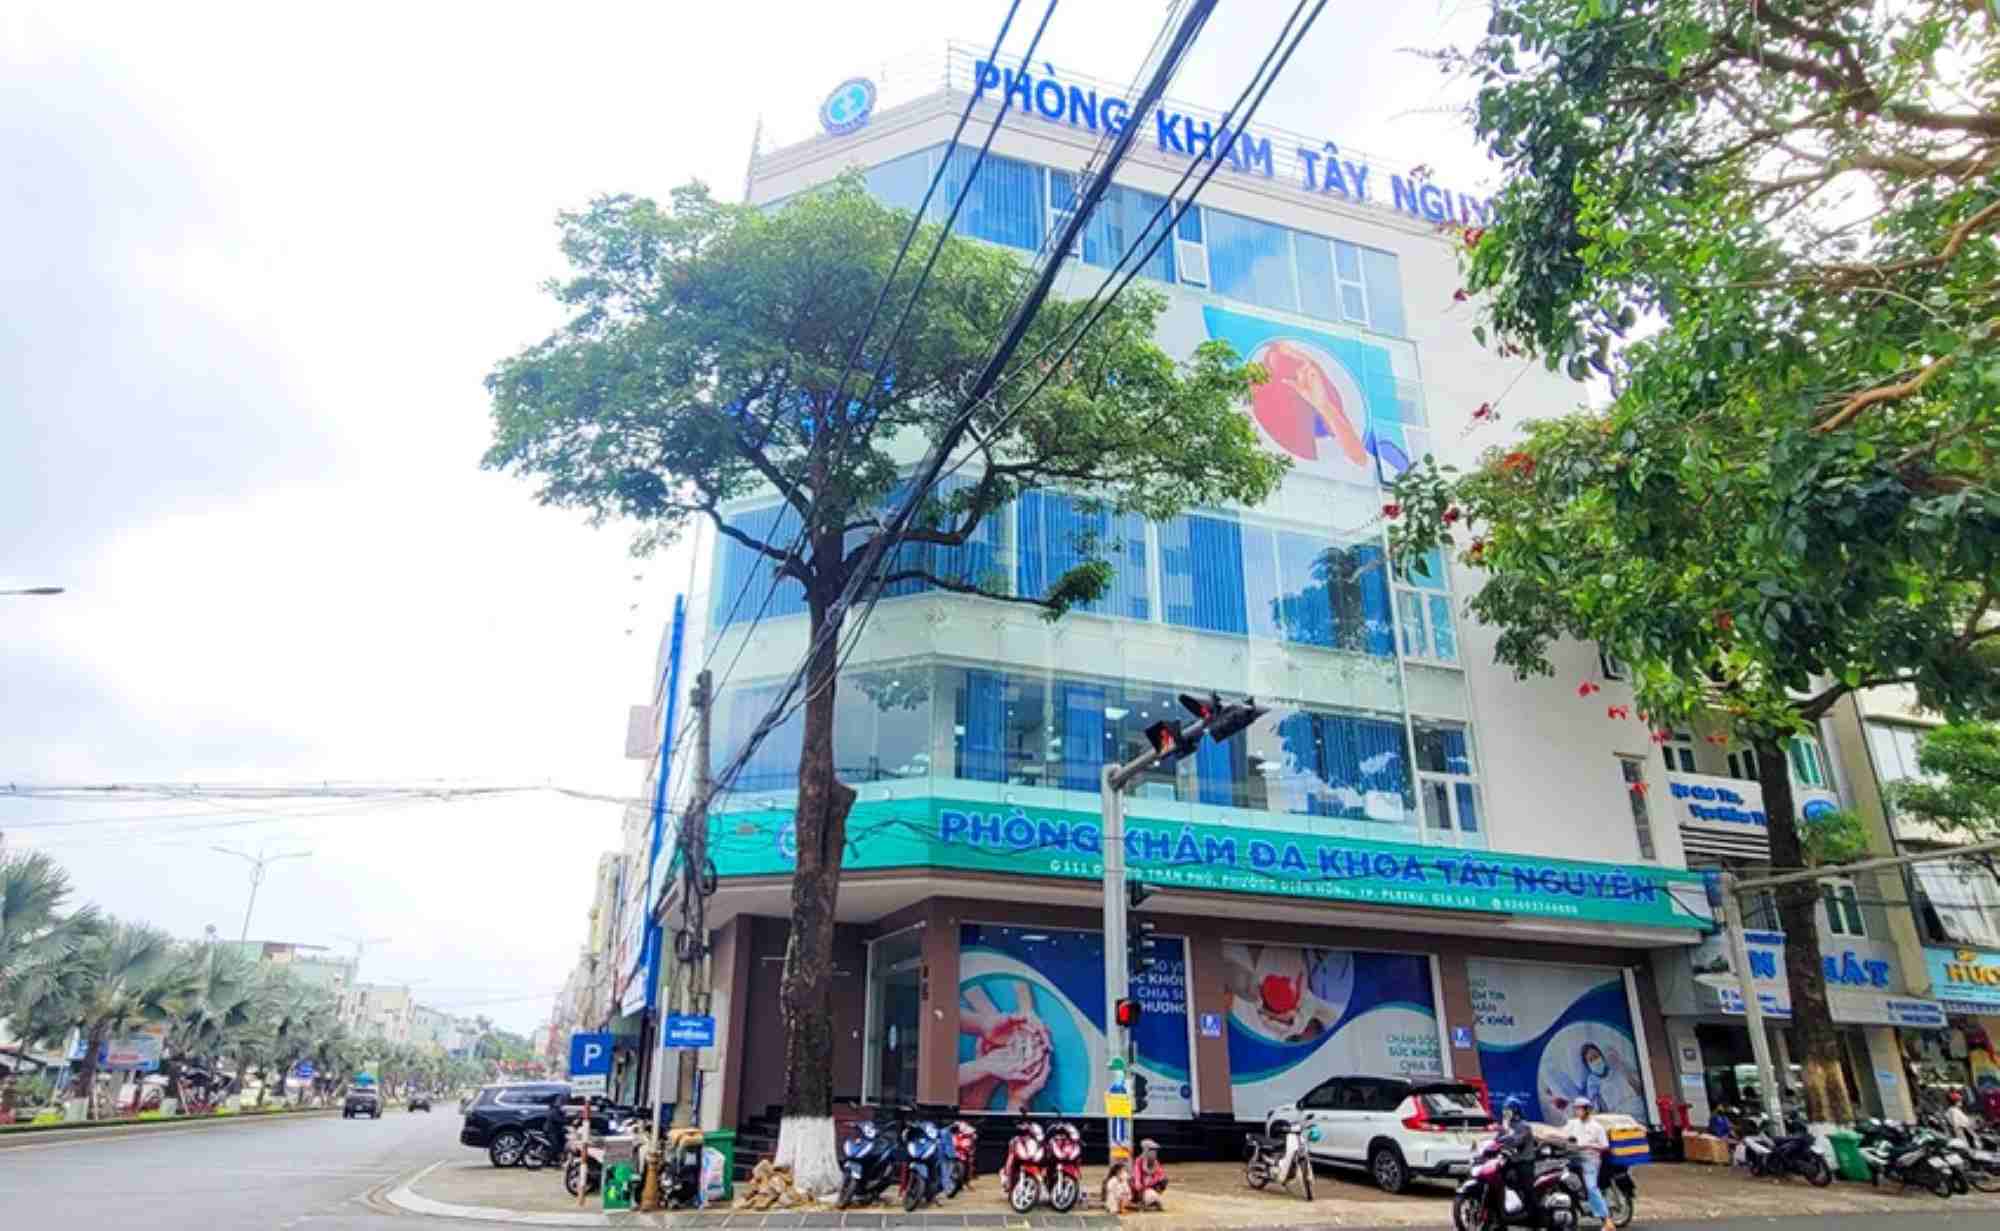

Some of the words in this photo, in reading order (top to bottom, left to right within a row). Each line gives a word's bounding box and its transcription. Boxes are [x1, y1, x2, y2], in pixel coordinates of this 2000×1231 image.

[975, 60, 1129, 136] PHÒNG
[1297, 141, 1369, 203] TÂY
[939, 807, 1102, 855] PHÒNG
[1248, 838, 1309, 873] ĐA
[1316, 846, 1427, 884] KHOA
[1433, 851, 1501, 888] TÂY
[1512, 864, 1658, 904] NGUYÊN
[584, 1043, 603, 1067] P
